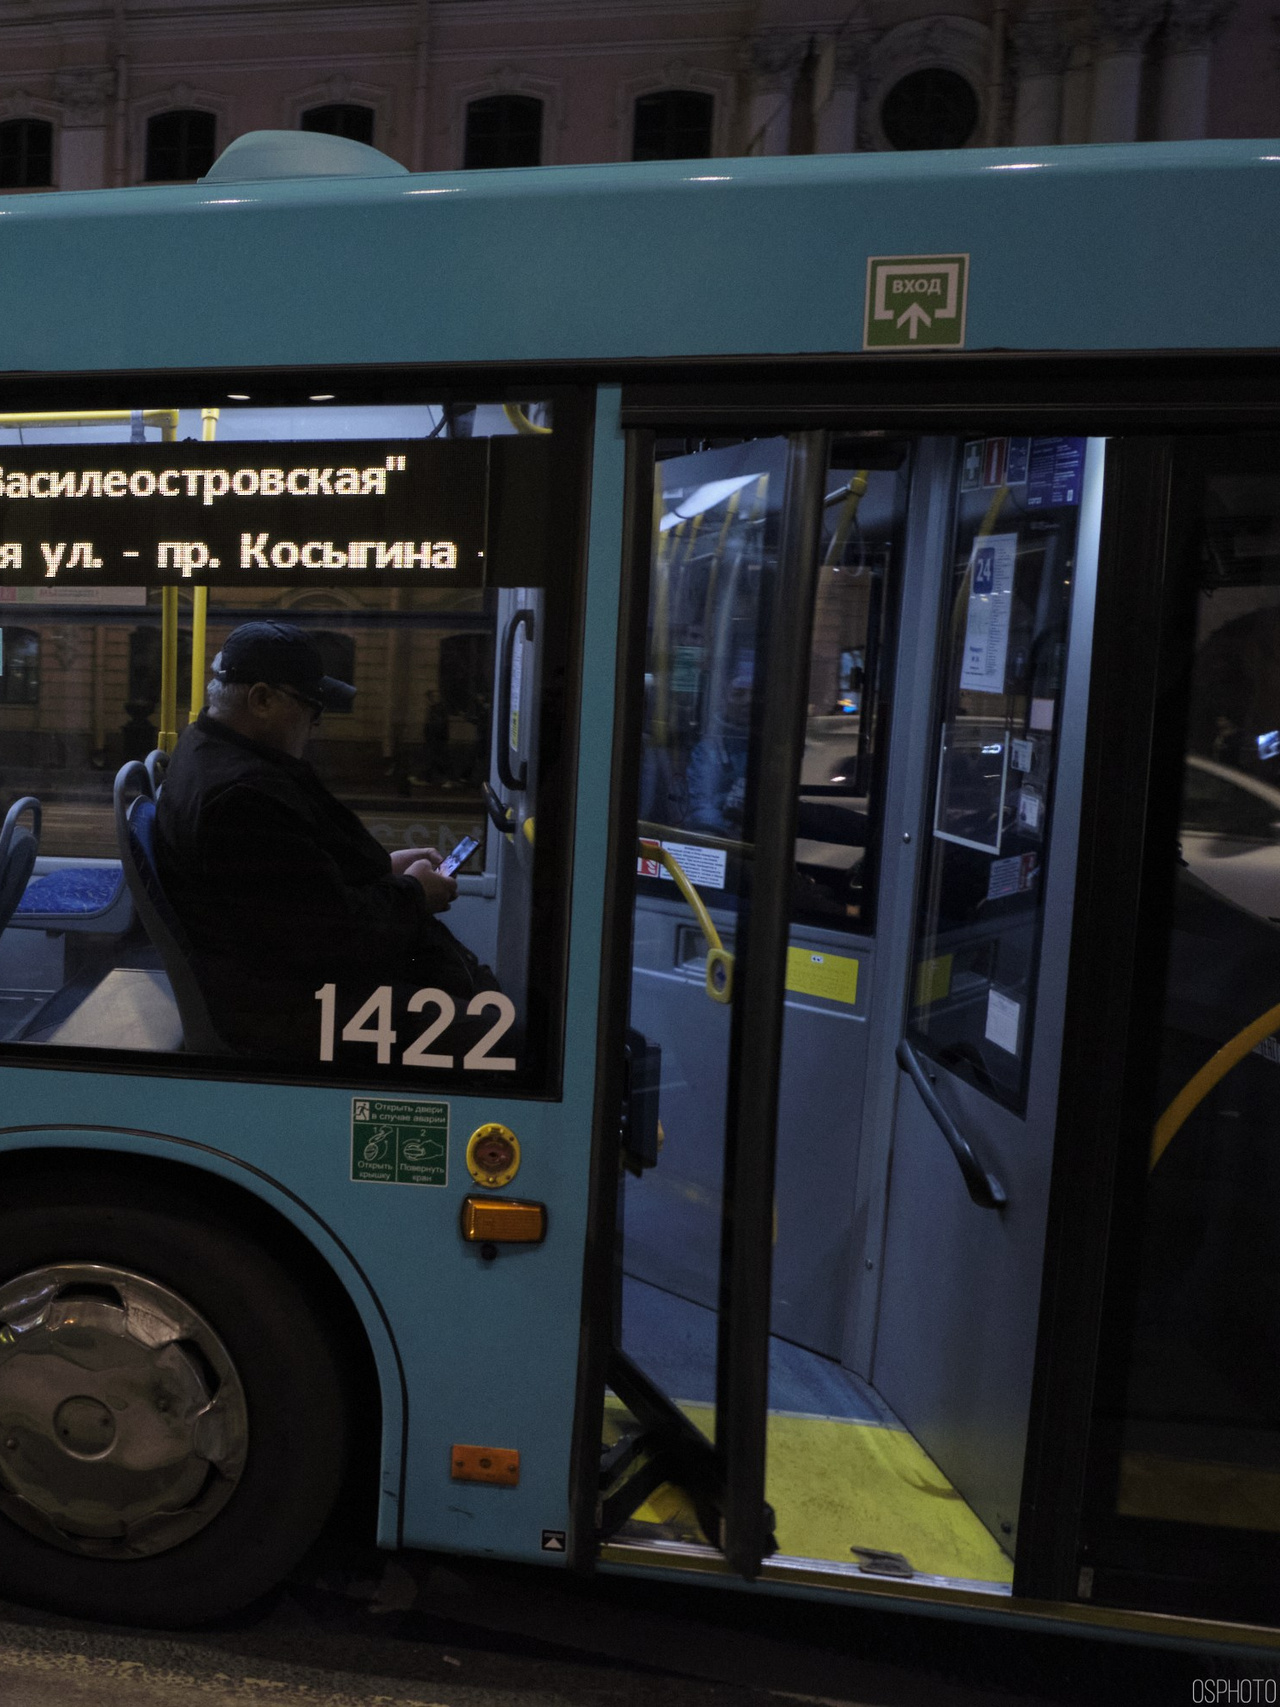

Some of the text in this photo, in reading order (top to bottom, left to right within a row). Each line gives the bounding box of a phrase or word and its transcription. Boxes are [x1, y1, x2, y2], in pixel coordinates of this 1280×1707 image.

[892, 278, 941, 296] ВХОД
[40, 543, 103, 578] ул.
[157, 542, 220, 578] пр.
[240, 533, 457, 569] Косыгина
[976, 558, 992, 582] 24
[314, 982, 516, 1072] 1422
[374, 1102, 443, 1116] Открыть двери
[380, 1114, 410, 1122] случае
[413, 1116, 446, 1124] аварии
[420, 1129, 426, 1137] 2
[358, 1161, 444, 1174] Открыть Повернуть
[359, 1170, 432, 1182] крышку кран
